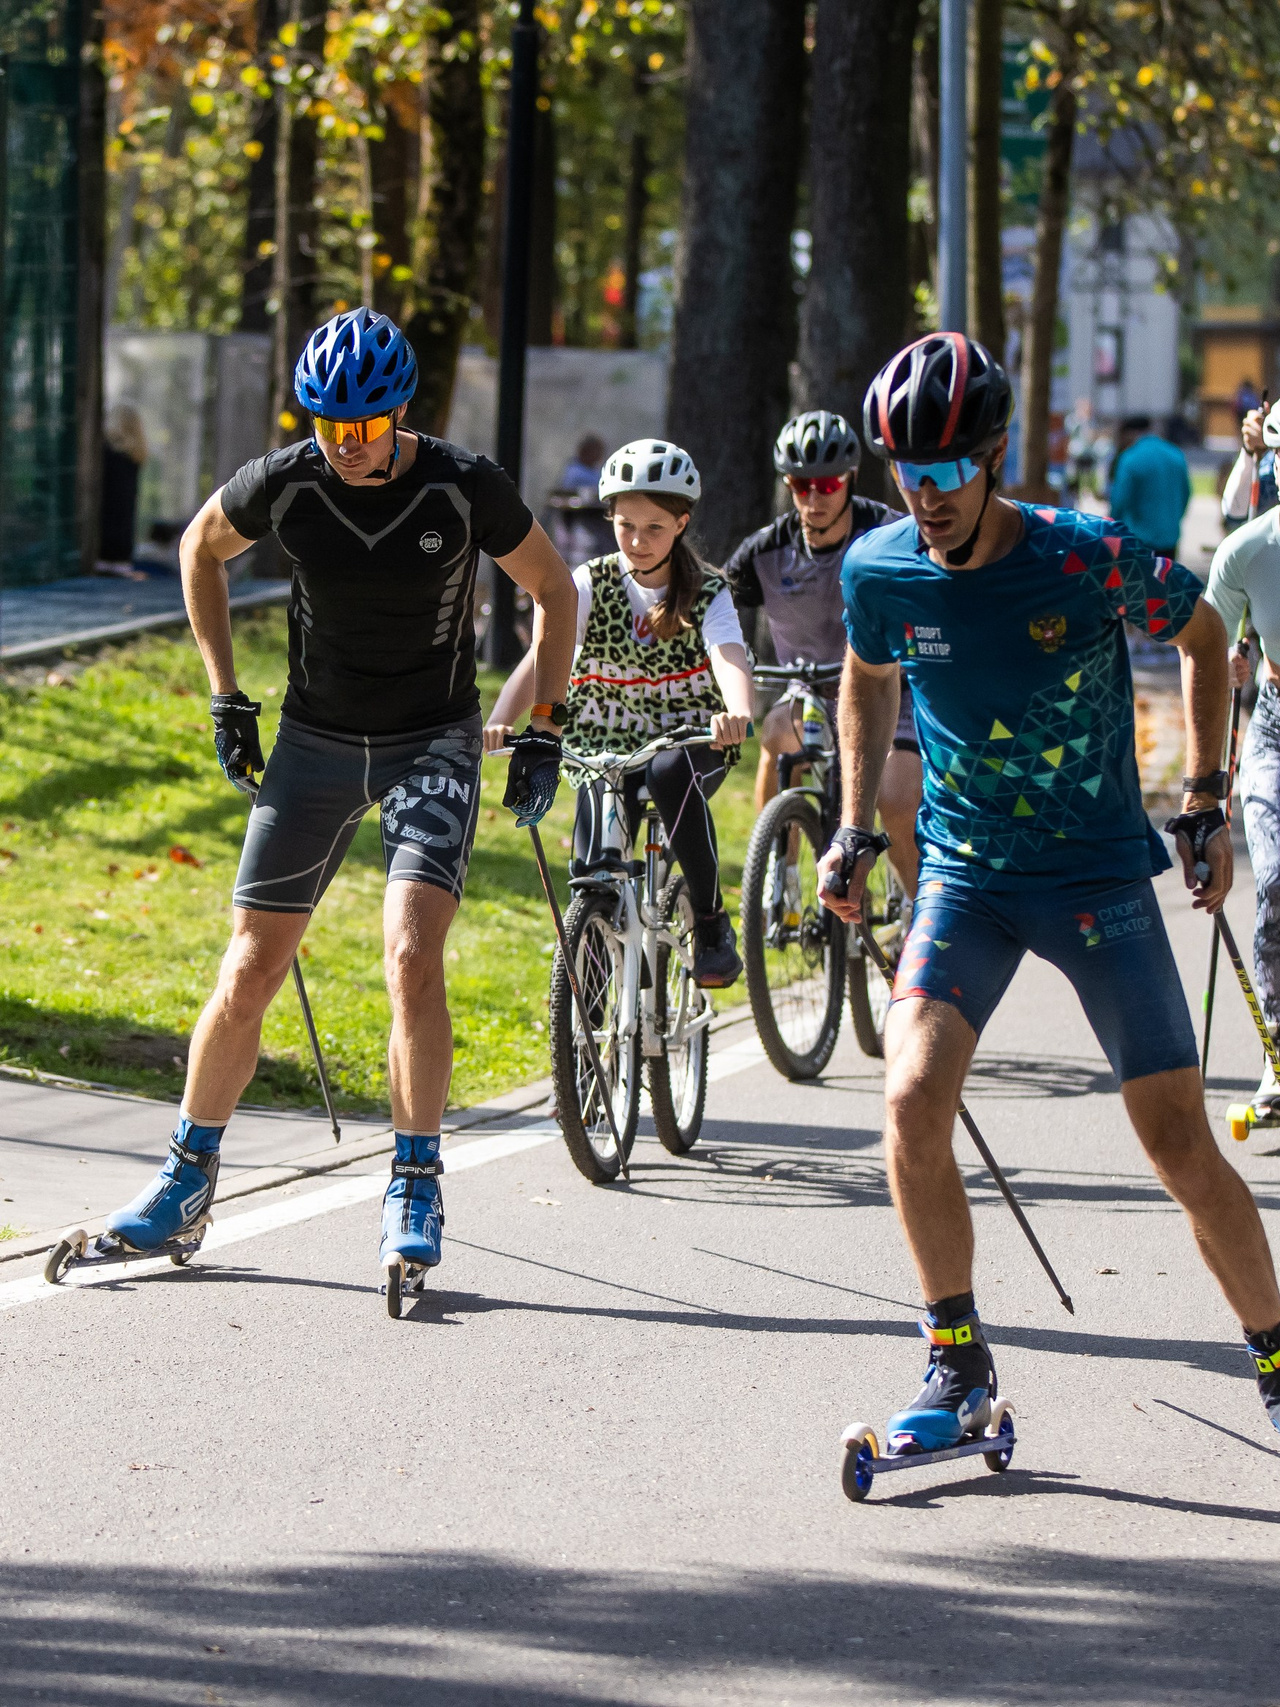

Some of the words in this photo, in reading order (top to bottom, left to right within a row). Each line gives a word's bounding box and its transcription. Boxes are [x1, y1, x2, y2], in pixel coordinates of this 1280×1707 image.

[914, 626, 942, 639] СПОРТ
[917, 641, 951, 656] ВЕКТОР
[1098, 900, 1143, 922] СПОРТ
[1103, 916, 1153, 939] ВЕКТОР
[1247, 999, 1280, 1066] FORZA
[395, 1165, 436, 1175] SPINE
